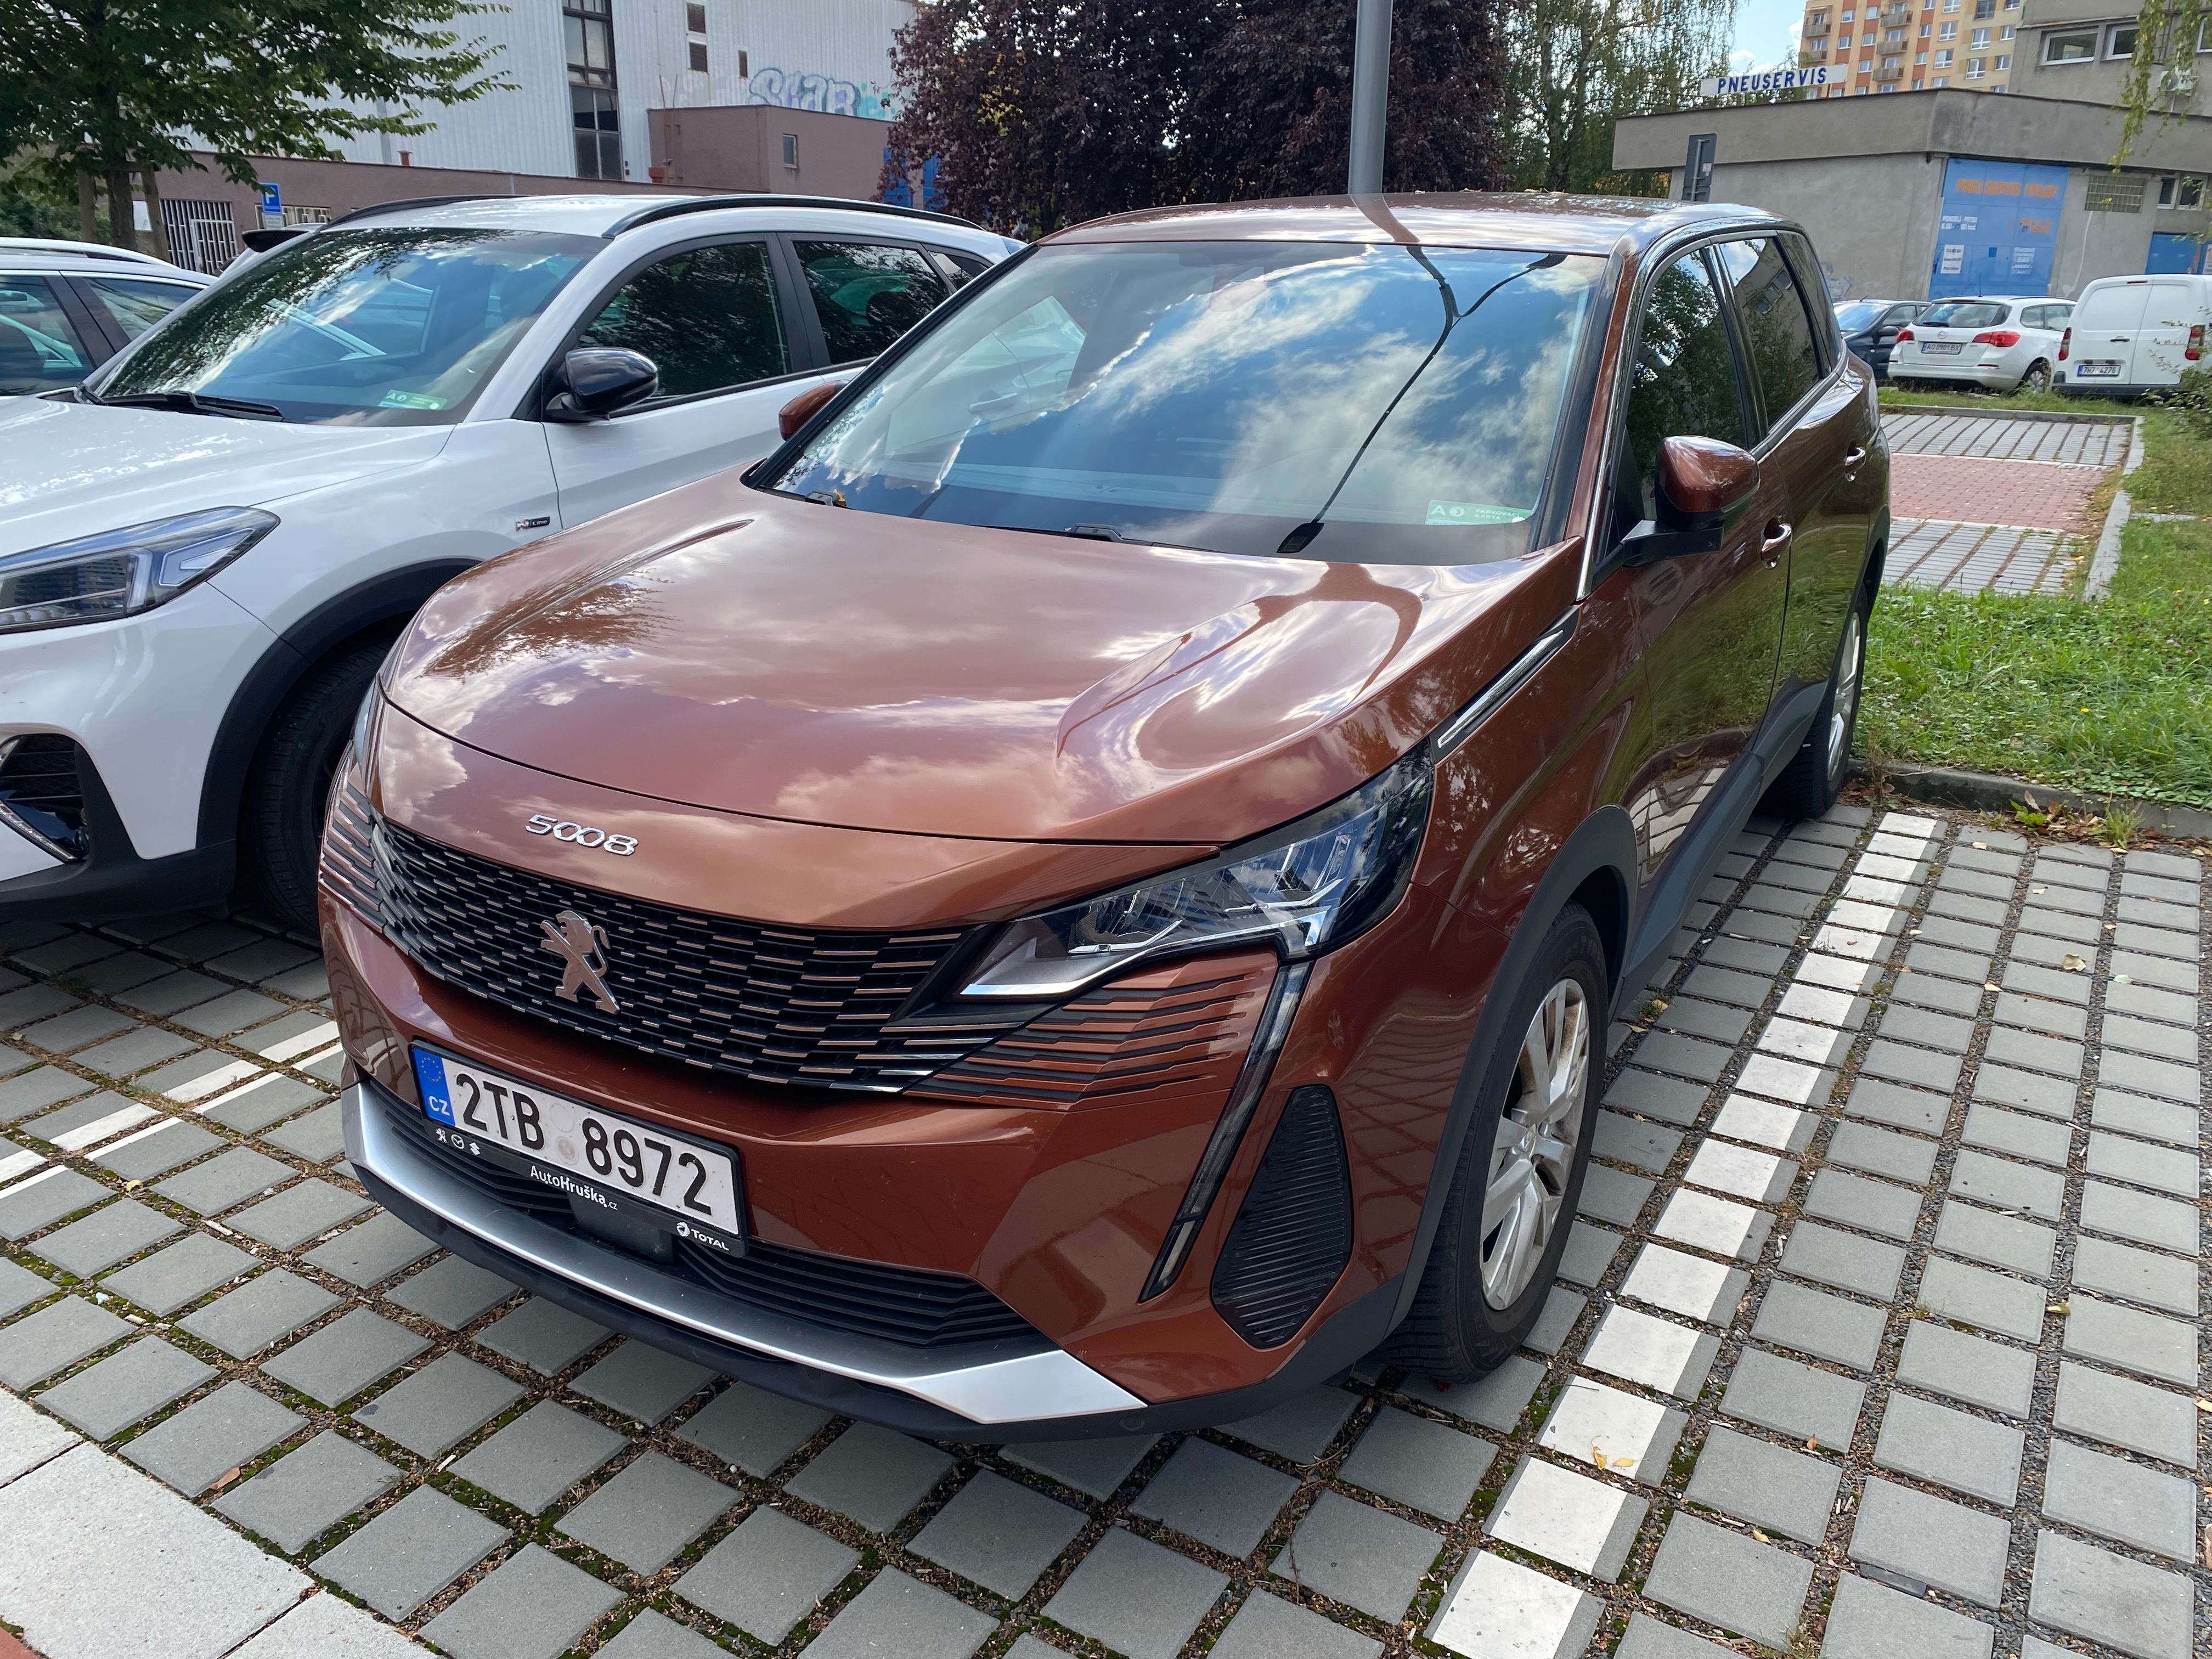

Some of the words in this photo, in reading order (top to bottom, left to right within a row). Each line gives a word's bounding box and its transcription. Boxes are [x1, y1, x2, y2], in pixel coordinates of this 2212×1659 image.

[1717, 67, 1827, 94] PNEUSERVIS
[1430, 505, 1446, 516] A
[1475, 508, 1520, 517] PARKOVACÍ
[525, 814, 639, 856] 5008
[428, 1096, 450, 1116] CZ
[456, 1073, 545, 1151] 2TB
[582, 1118, 712, 1215] 8972
[691, 1228, 730, 1251] TOTAL
